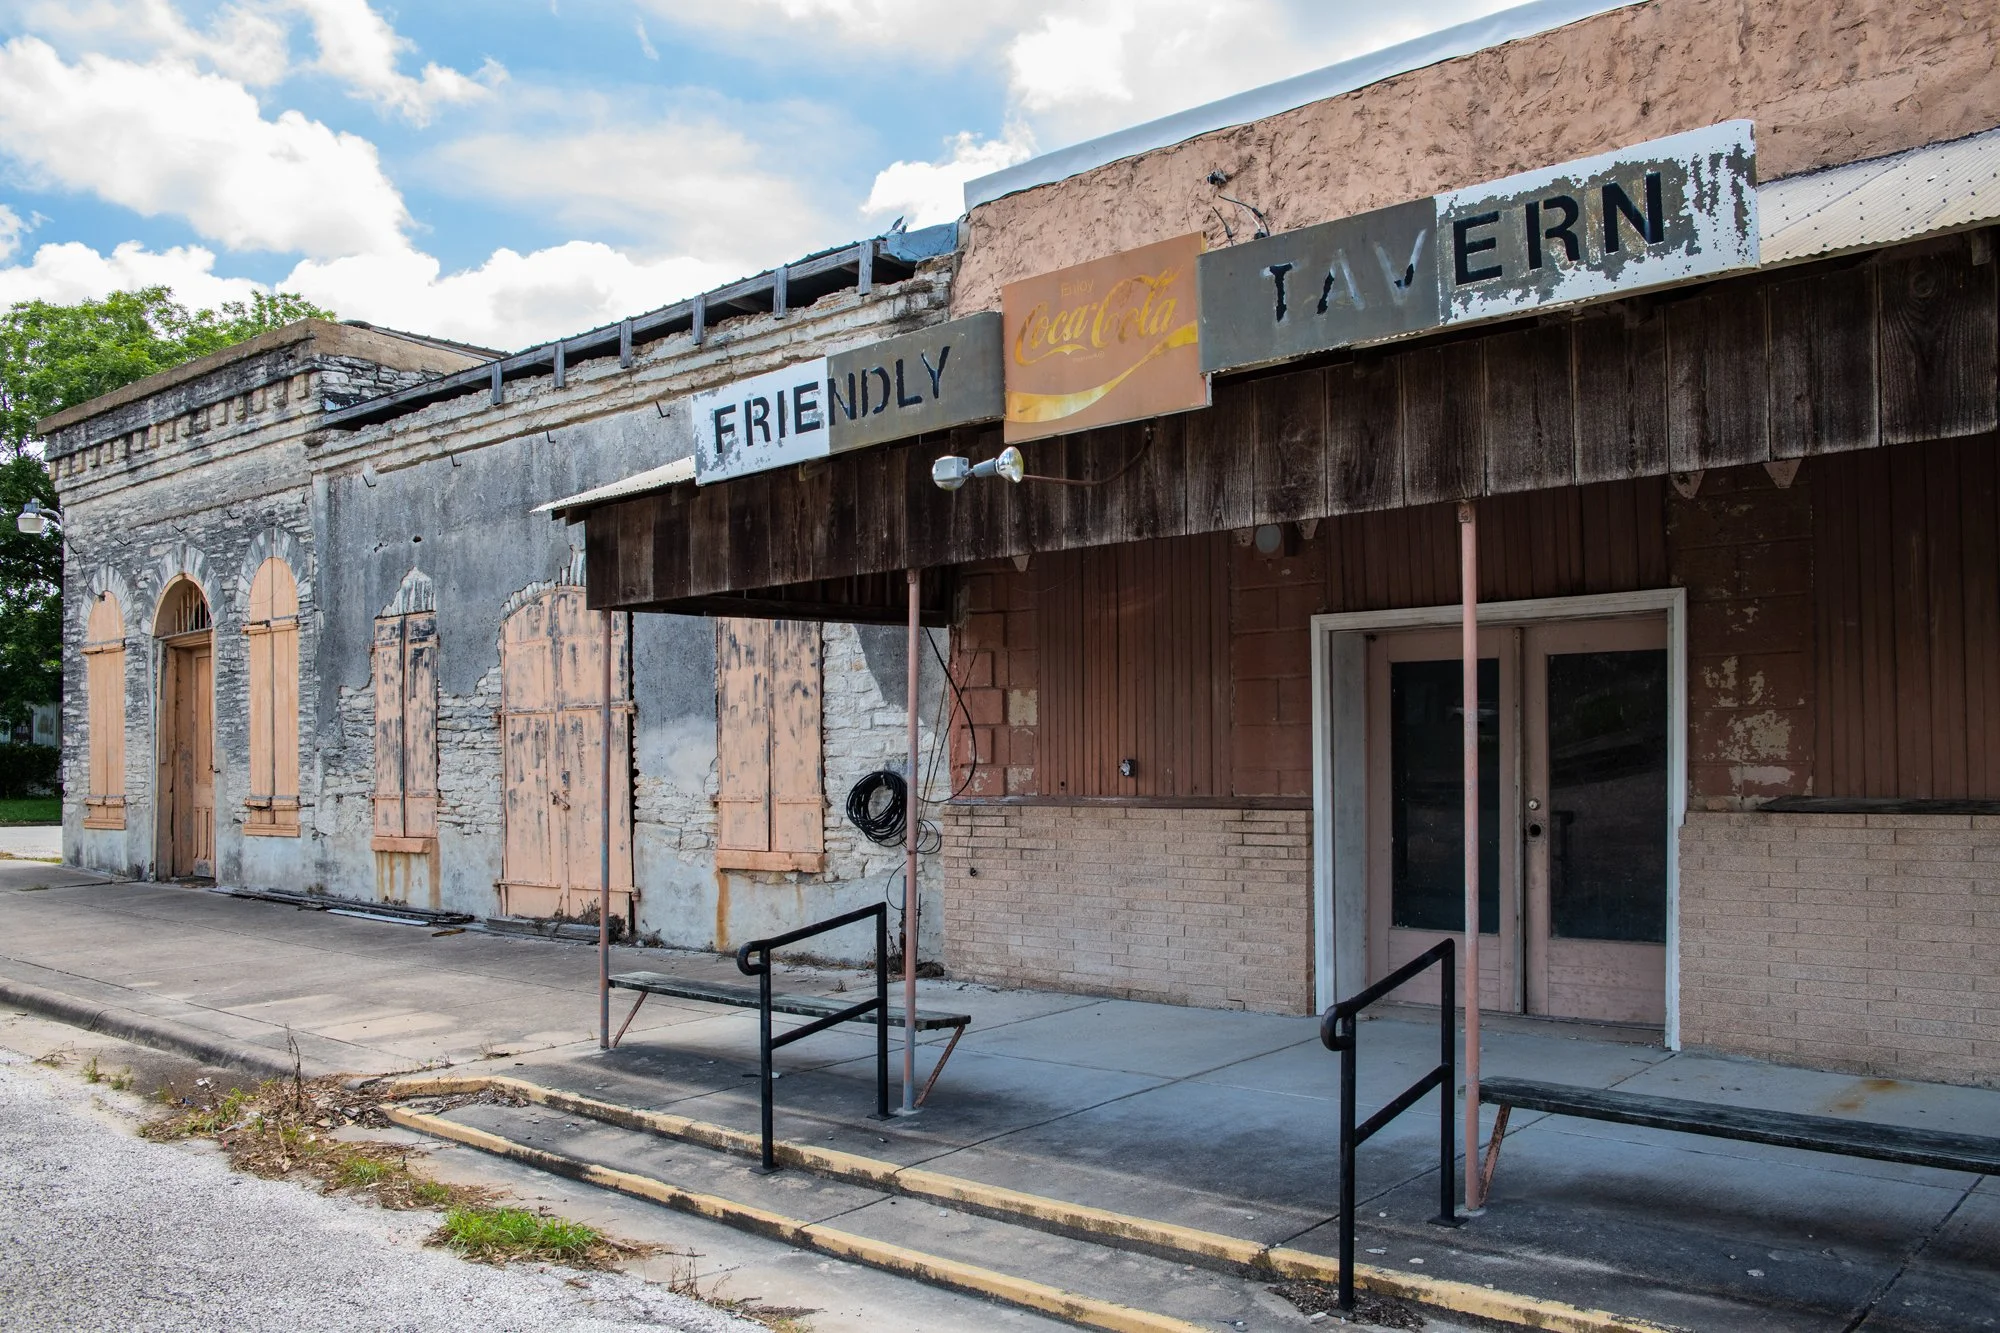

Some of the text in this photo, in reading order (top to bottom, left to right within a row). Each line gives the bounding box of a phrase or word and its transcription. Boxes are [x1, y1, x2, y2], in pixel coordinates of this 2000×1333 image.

[1061, 278, 1095, 298] Enjoy
[1260, 171, 1665, 329] TAVERN
[1014, 264, 1184, 367] Coca-Cola
[714, 345, 951, 454] FRIENDLY
